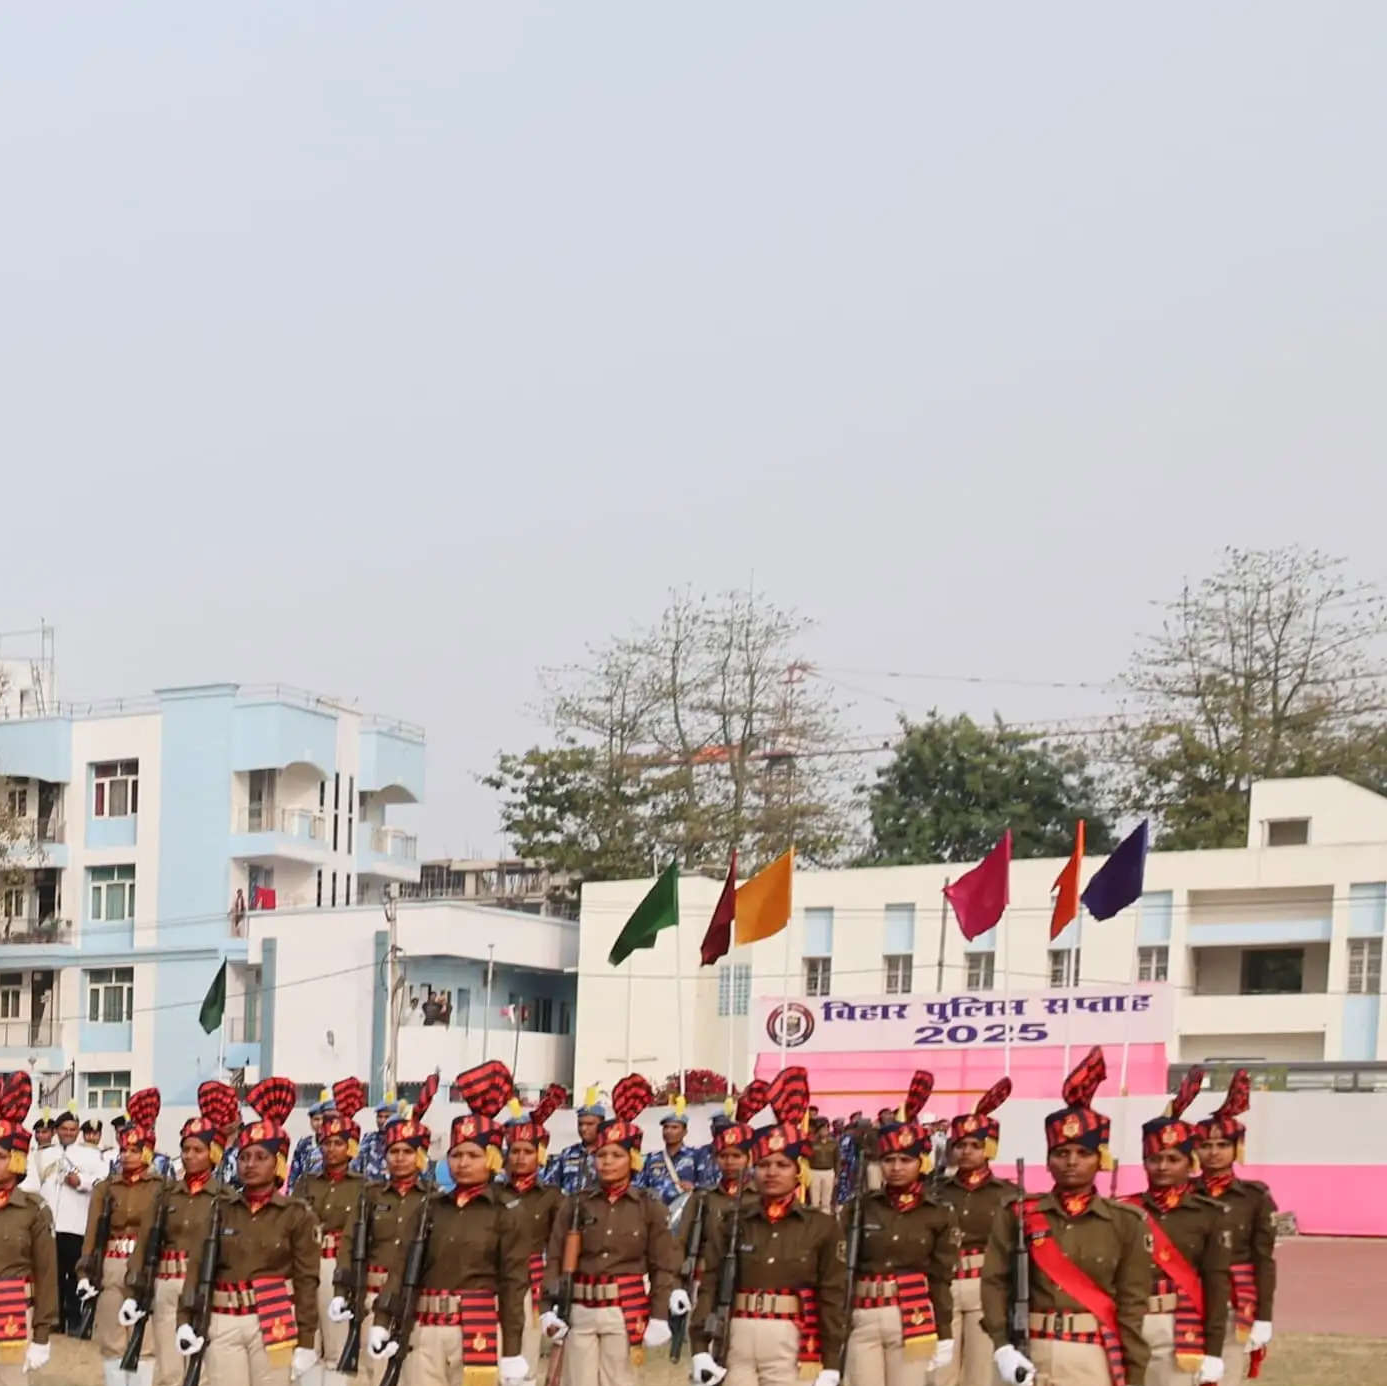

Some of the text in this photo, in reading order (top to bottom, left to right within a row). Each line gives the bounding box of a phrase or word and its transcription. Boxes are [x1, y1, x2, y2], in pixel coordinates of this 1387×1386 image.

[924, 996, 1028, 1024] पुलिस
[1042, 994, 1152, 1015] सप्ताह
[914, 1023, 1048, 1044] 2025
